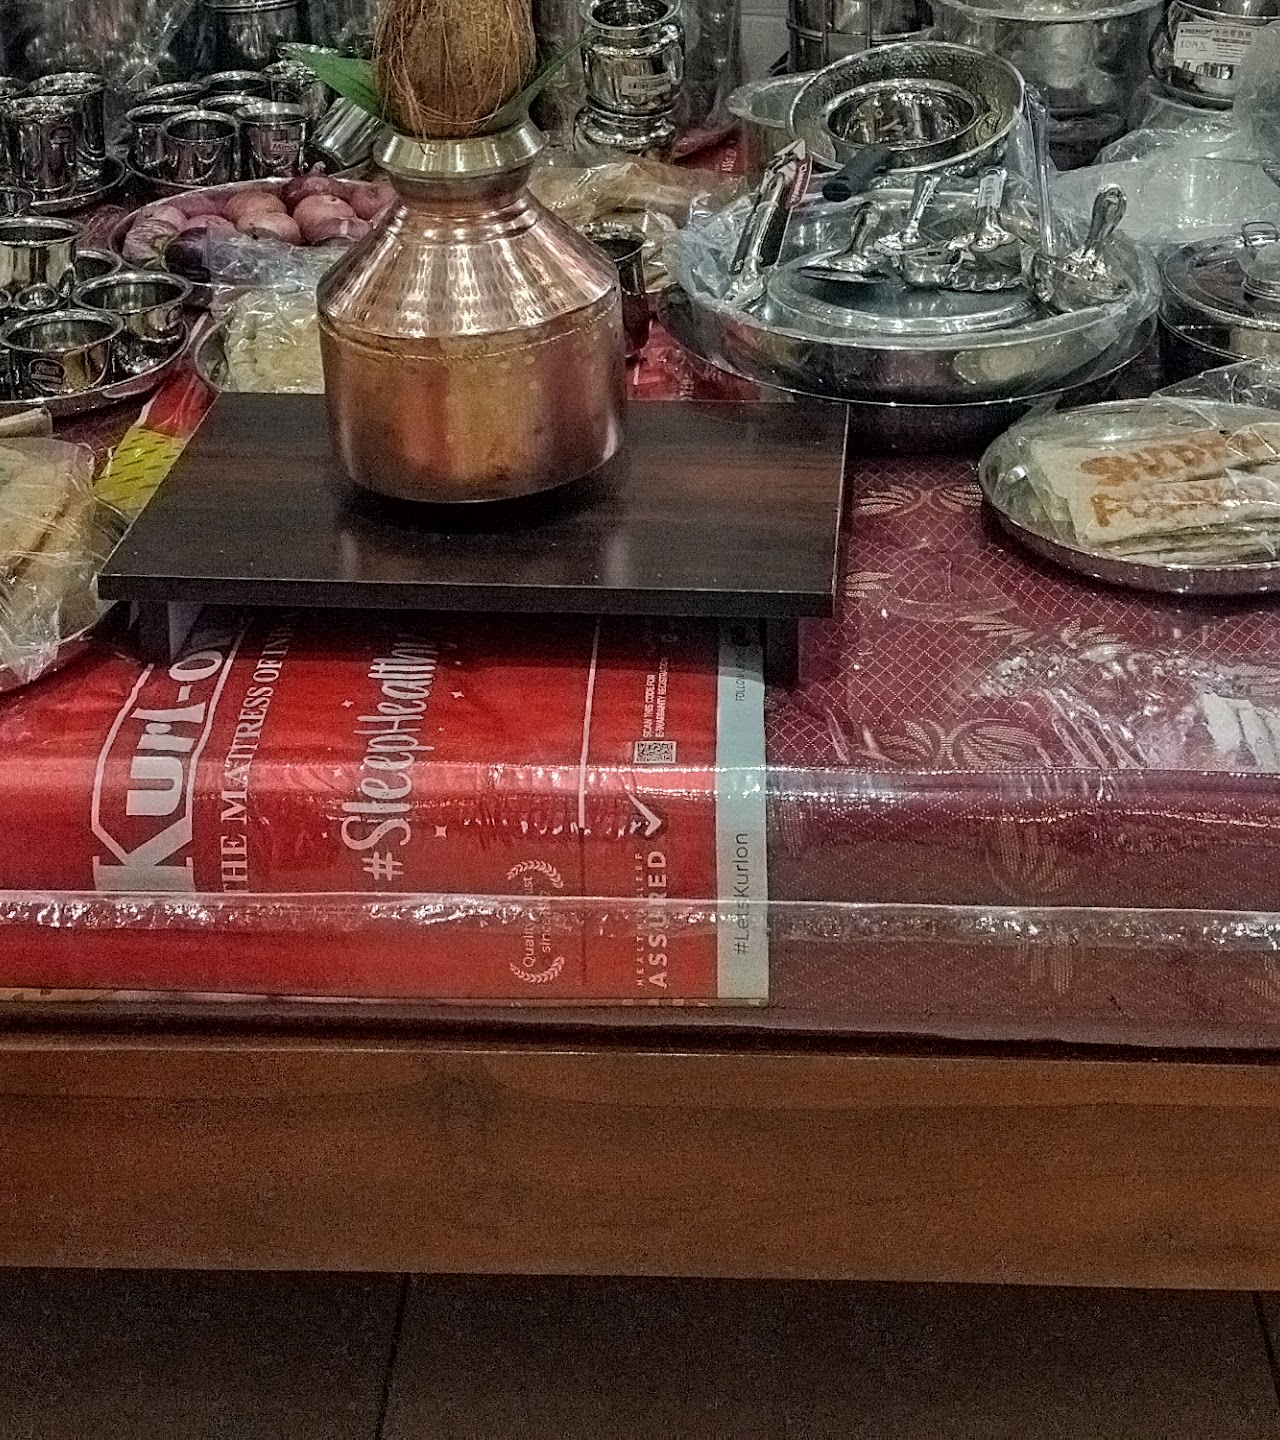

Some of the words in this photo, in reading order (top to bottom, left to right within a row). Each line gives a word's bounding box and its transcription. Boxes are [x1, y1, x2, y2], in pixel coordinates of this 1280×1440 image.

[252, 659, 283, 683] OF
[643, 703, 654, 718] THIS
[91, 650, 223, 893] Kurl-o
[221, 686, 275, 825] MATTRESS
[220, 834, 248, 893] THE
[646, 850, 669, 990] ASSURED
[732, 832, 752, 955] #LetsKurlon
